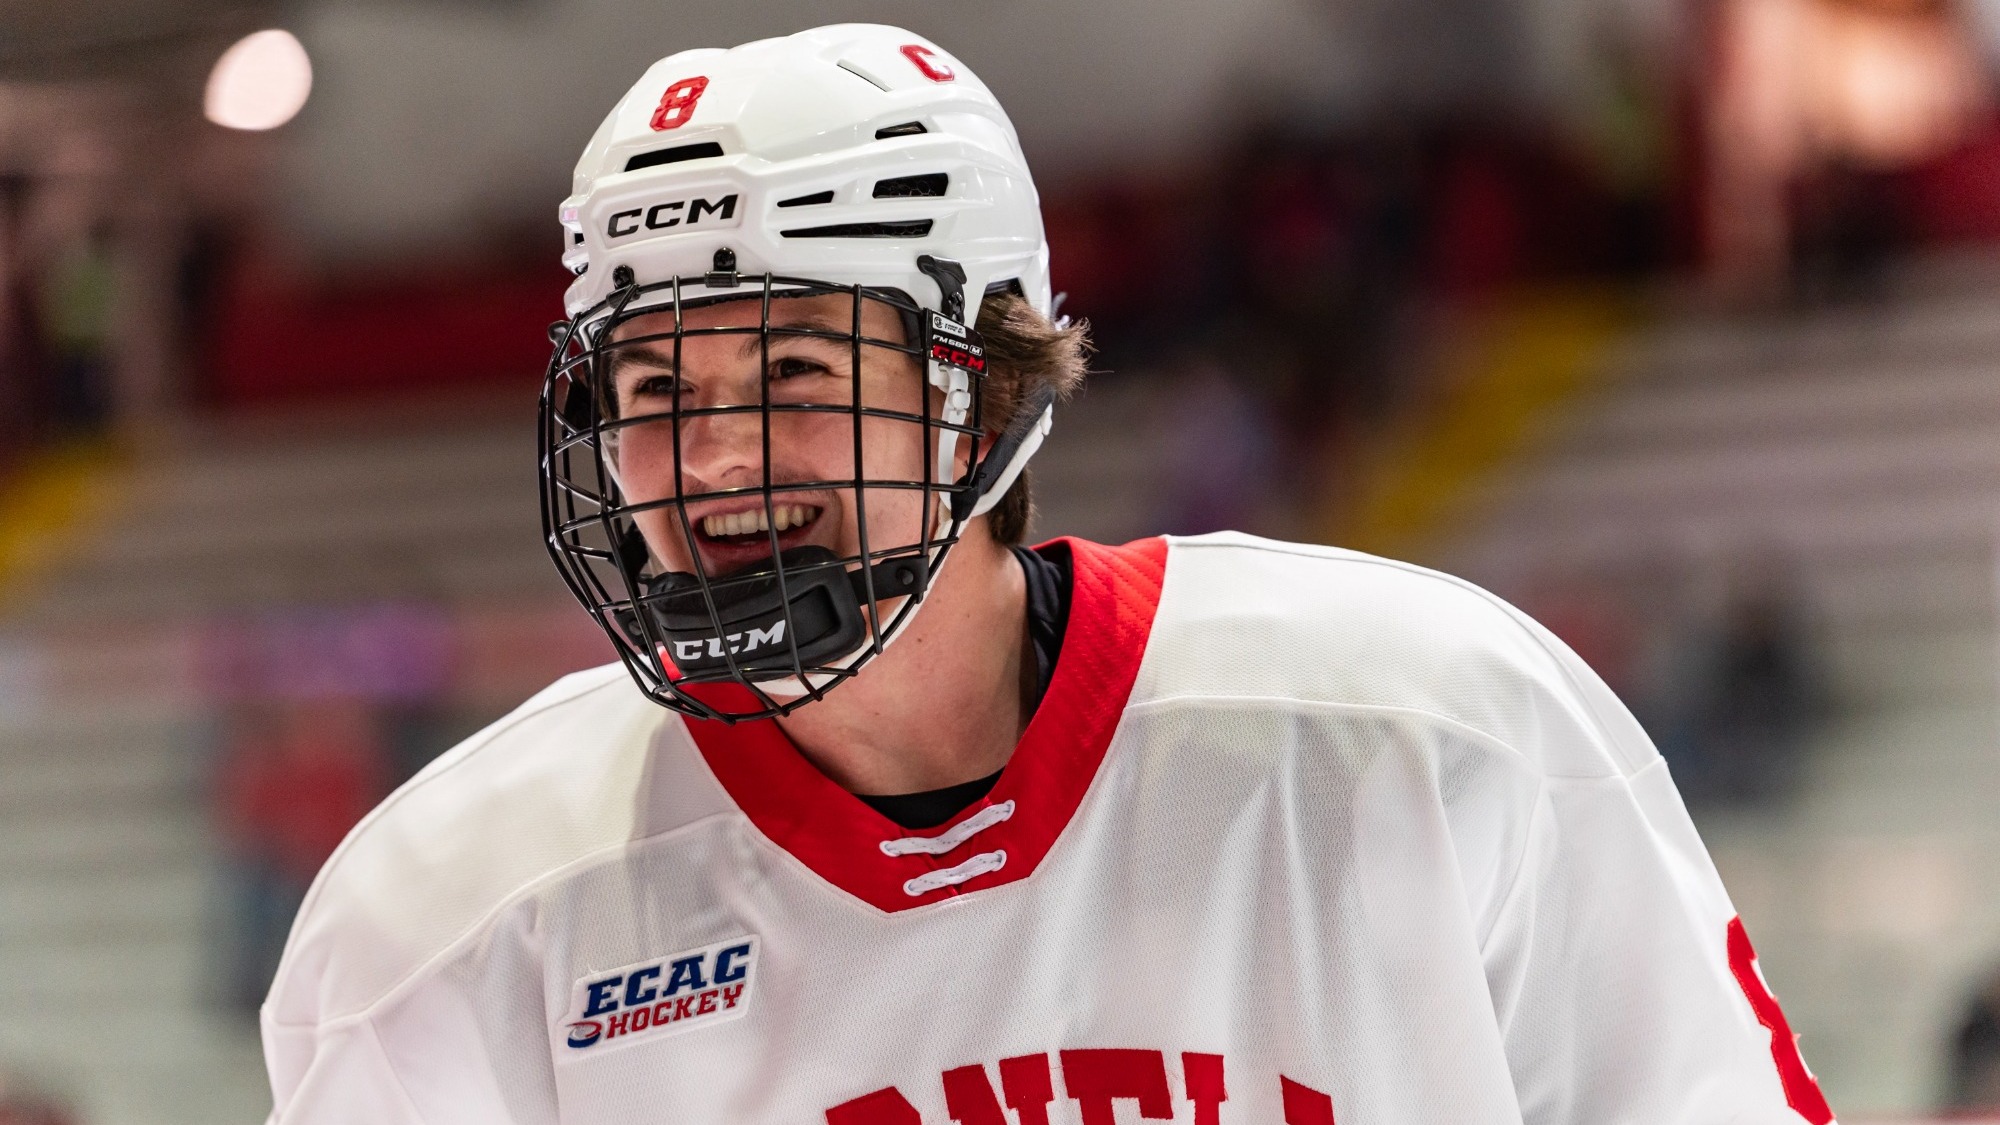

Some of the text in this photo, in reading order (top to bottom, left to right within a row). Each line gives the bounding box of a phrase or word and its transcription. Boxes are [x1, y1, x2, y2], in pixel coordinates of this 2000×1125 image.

[899, 44, 956, 82] C
[649, 75, 710, 132] 8
[607, 193, 740, 239] CCM
[932, 345, 985, 372] CCM
[673, 619, 787, 660] CCM
[584, 943, 751, 1018] ECAC
[606, 983, 745, 1040] HOCKEY
